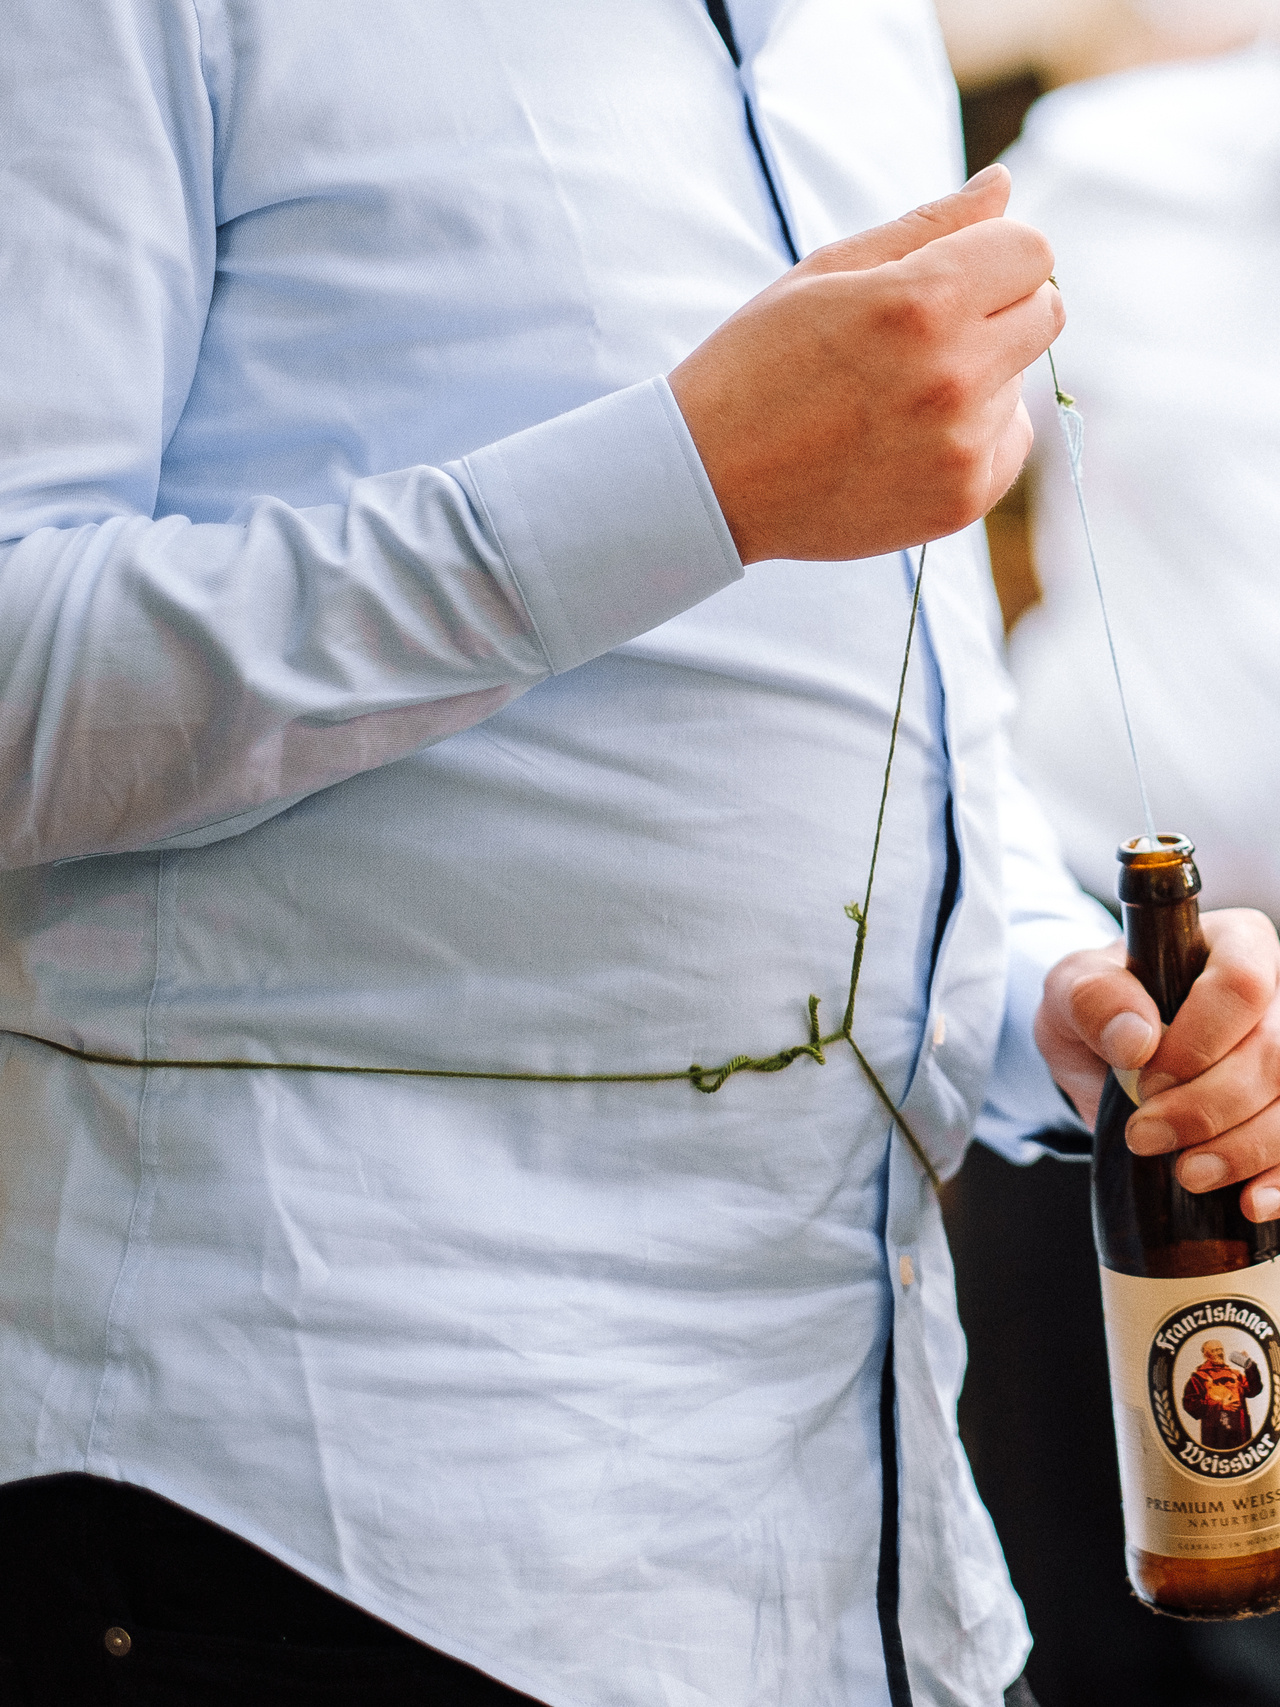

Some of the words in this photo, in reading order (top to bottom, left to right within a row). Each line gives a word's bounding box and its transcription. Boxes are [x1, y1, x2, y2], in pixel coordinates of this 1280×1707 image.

[1156, 1302, 1274, 1355] Franziskaner
[1180, 1433, 1275, 1475] Weissbier
[1146, 1497, 1225, 1514] PREMIUM
